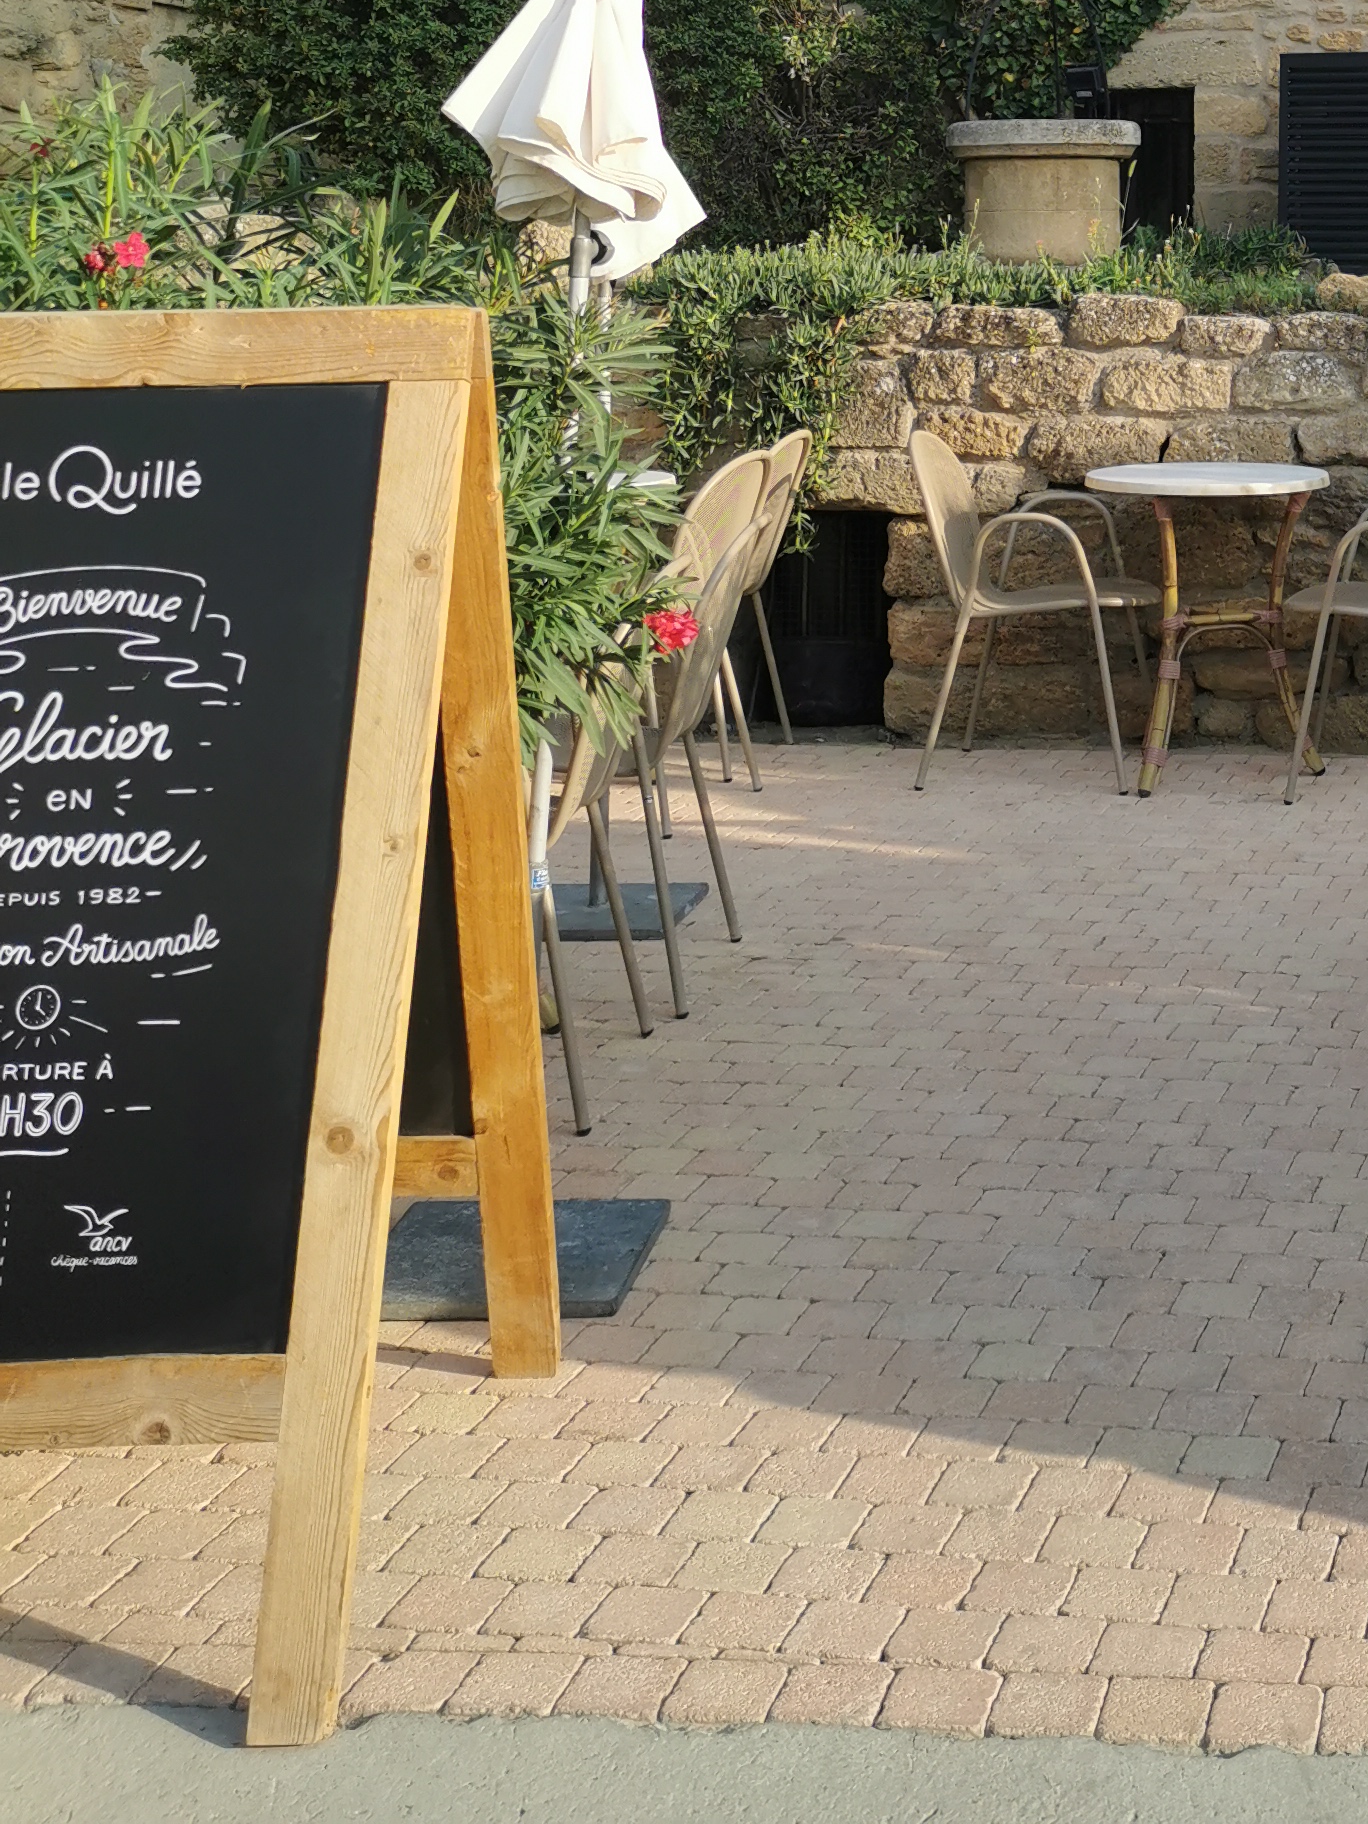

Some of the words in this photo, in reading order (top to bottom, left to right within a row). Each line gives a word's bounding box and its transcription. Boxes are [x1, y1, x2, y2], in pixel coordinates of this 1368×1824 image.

[2, 461, 41, 501] le
[48, 444, 203, 515] Quillé
[77, 886, 142, 905] 1982
[41, 913, 221, 967] Artisanale
[94, 1052, 114, 1081] À
[89, 1236, 133, 1253] ancv
